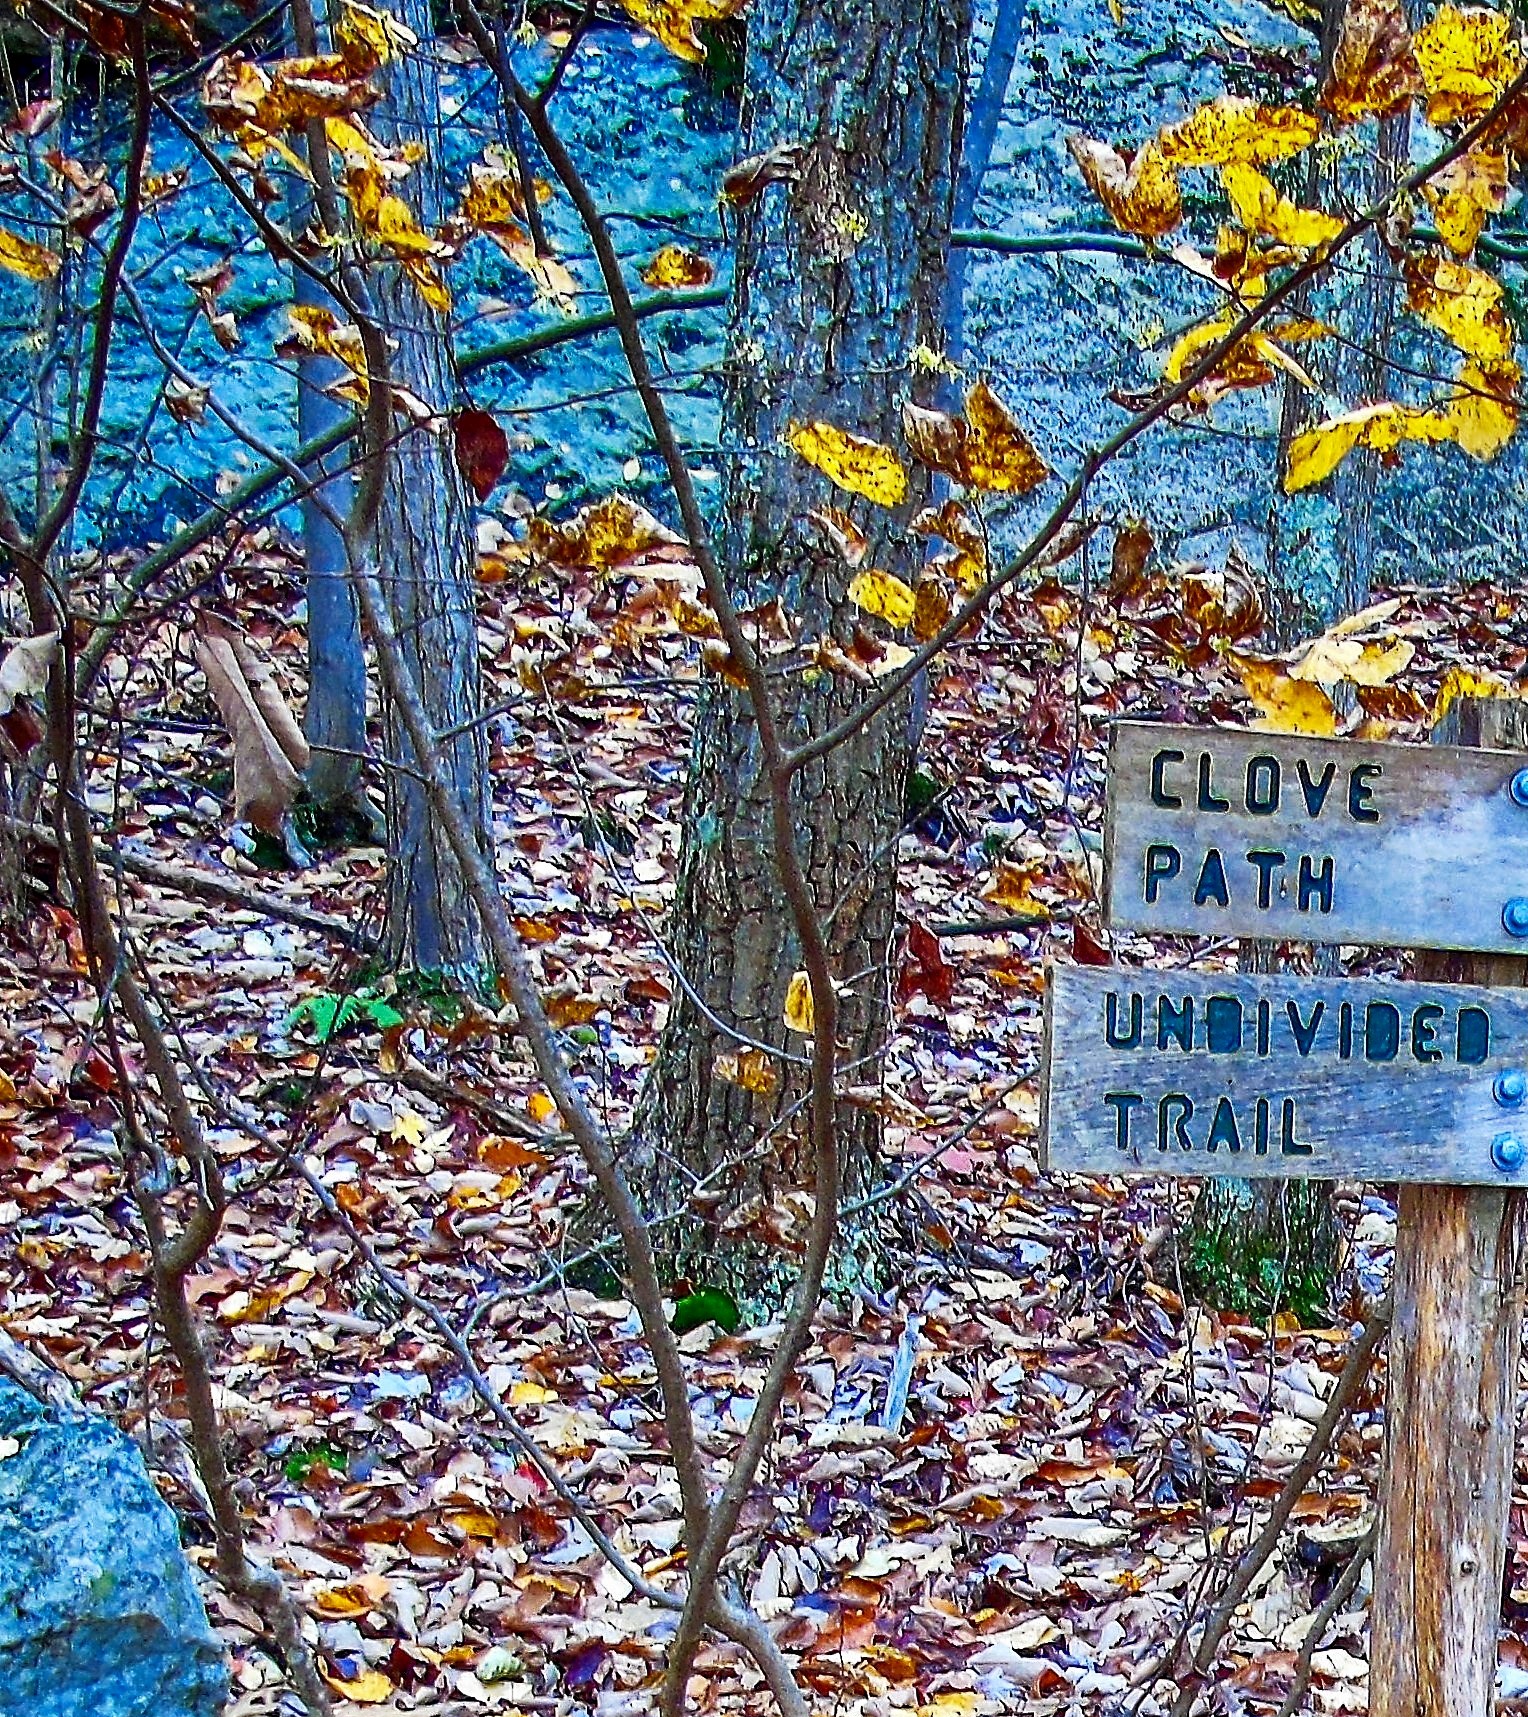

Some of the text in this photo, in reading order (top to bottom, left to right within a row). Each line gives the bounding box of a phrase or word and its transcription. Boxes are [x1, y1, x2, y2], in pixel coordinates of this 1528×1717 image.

[1150, 750, 1384, 823] CLOVE
[1144, 843, 1335, 914] PATH
[1105, 992, 1491, 1066] UNDIVIDED
[1104, 1093, 1314, 1156] TRAIL
